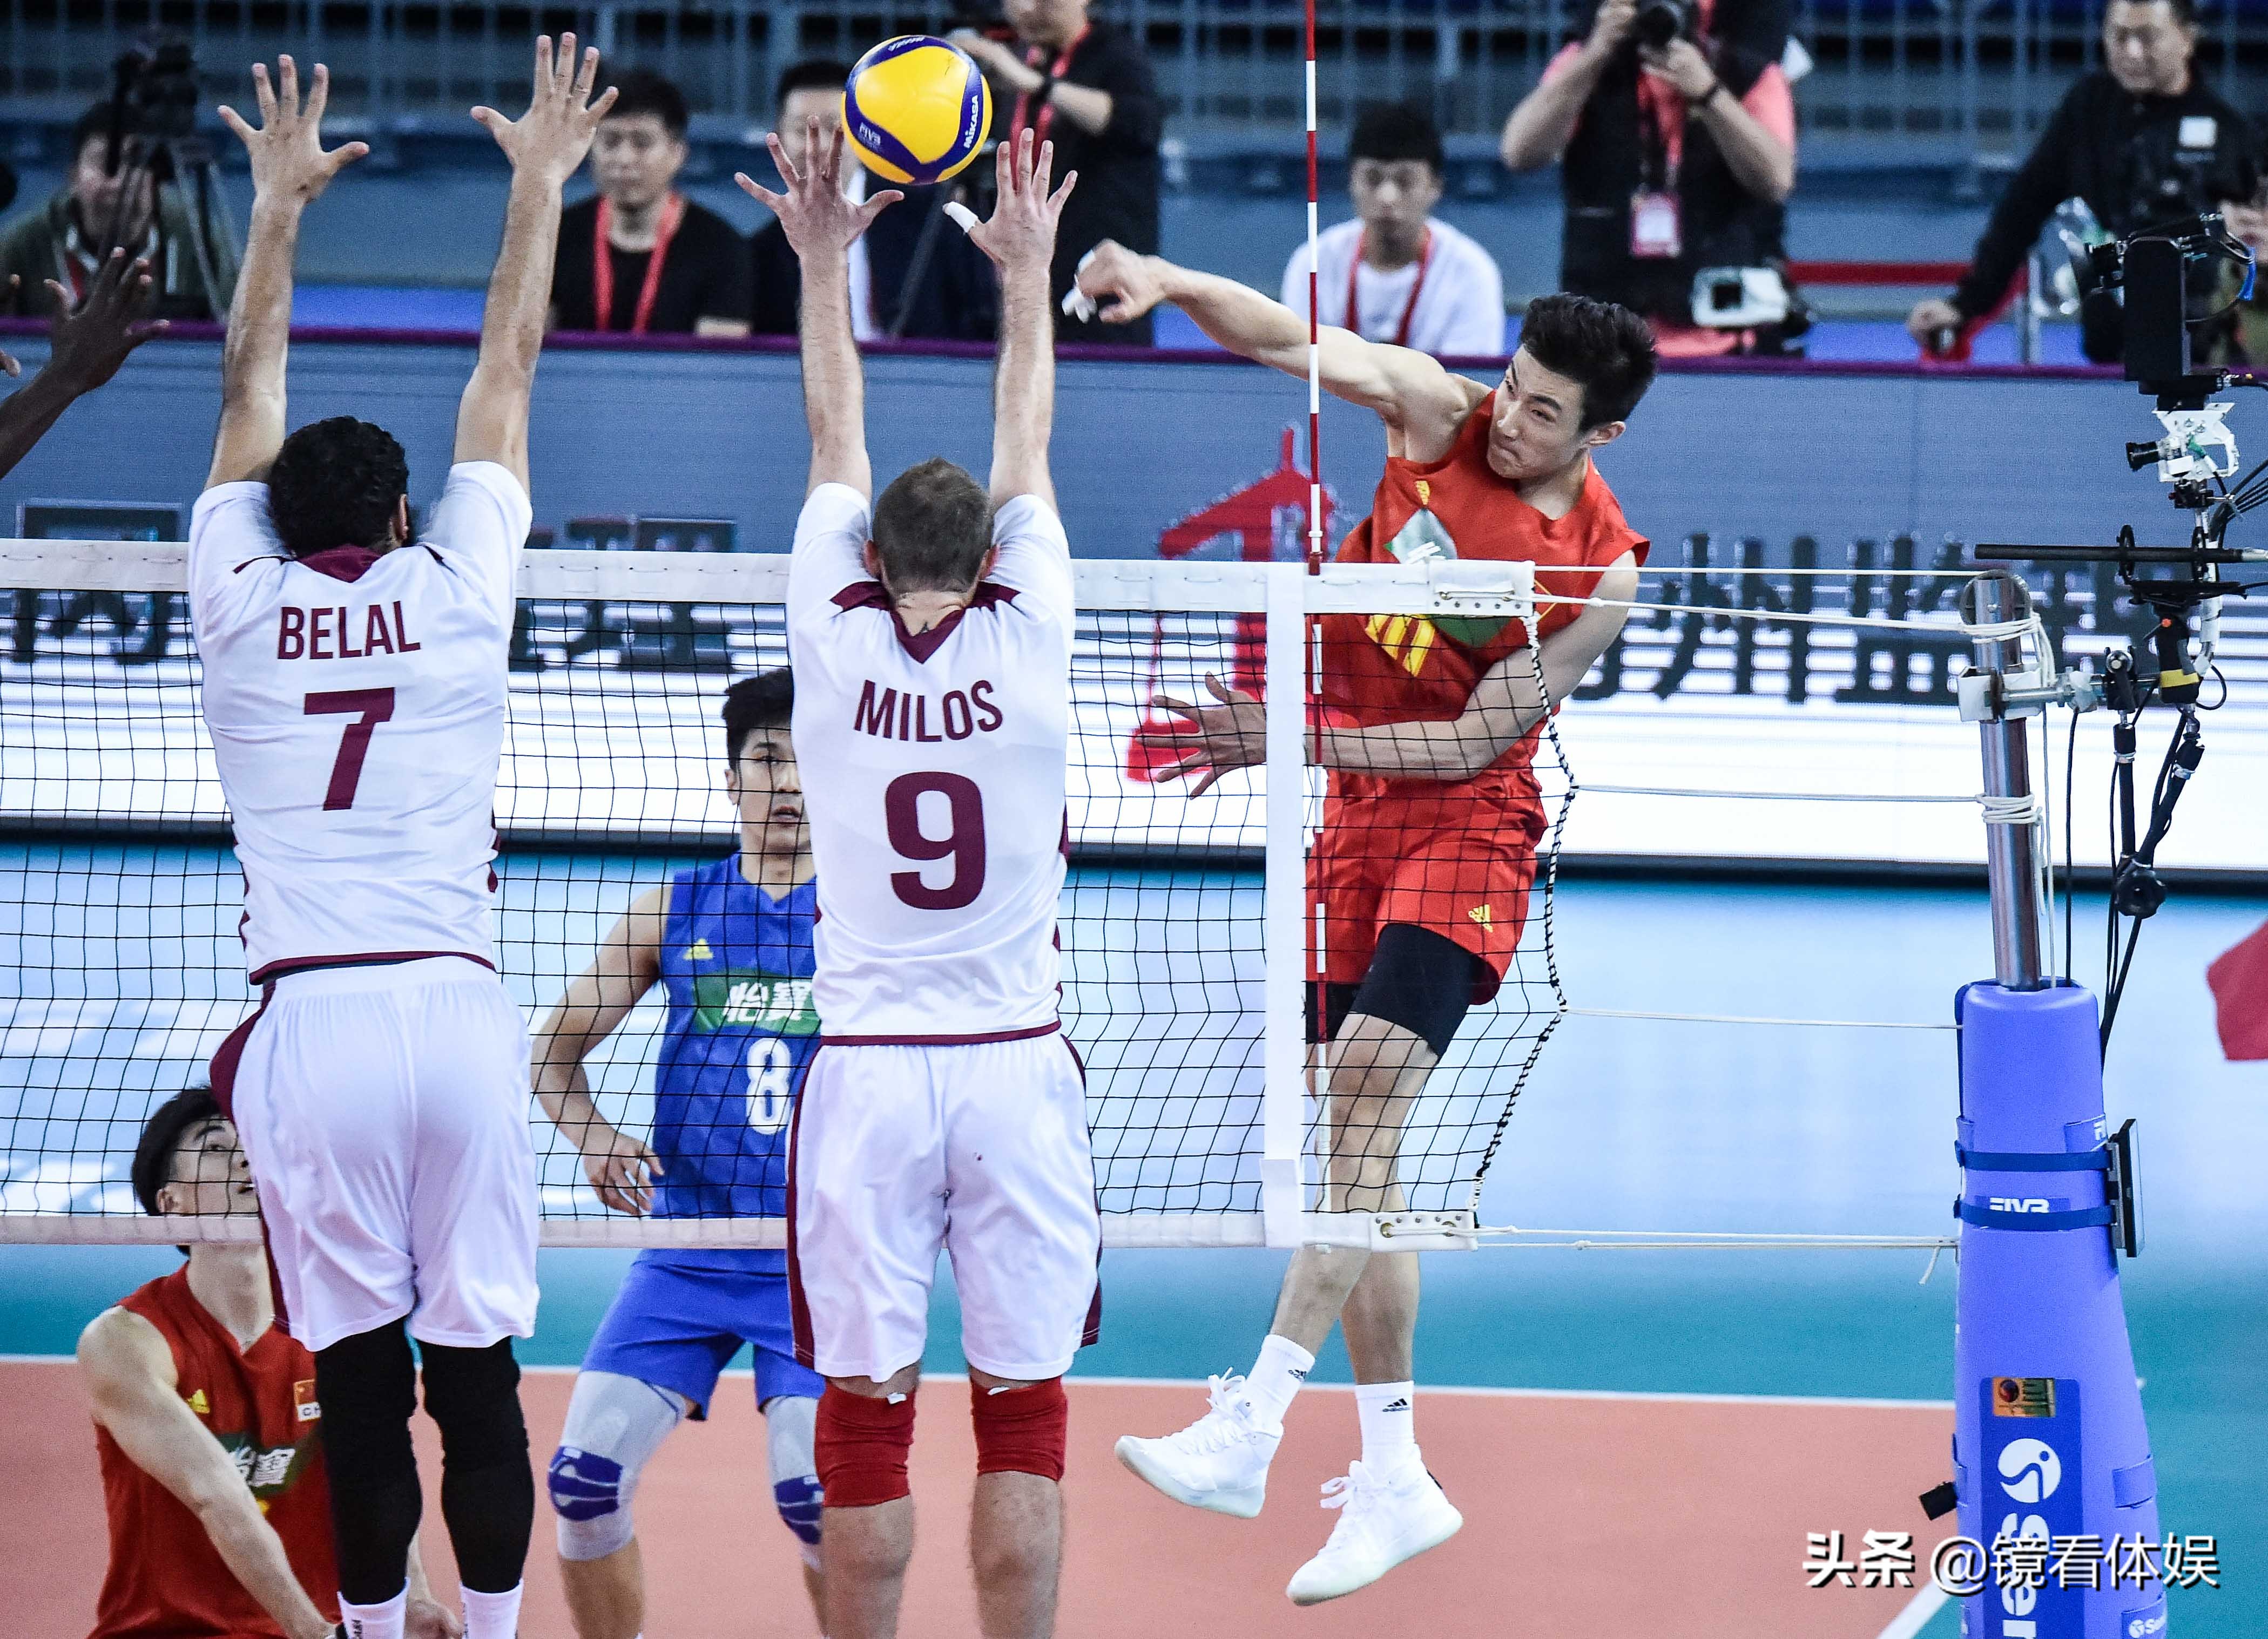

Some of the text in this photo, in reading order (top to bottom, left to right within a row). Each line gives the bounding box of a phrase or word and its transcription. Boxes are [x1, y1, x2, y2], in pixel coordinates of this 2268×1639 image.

[277, 600, 421, 660] BELAL
[303, 687, 395, 811] 7
[853, 679, 1003, 743] MILOS
[885, 771, 987, 909] 9
[746, 1038, 792, 1135] 8
